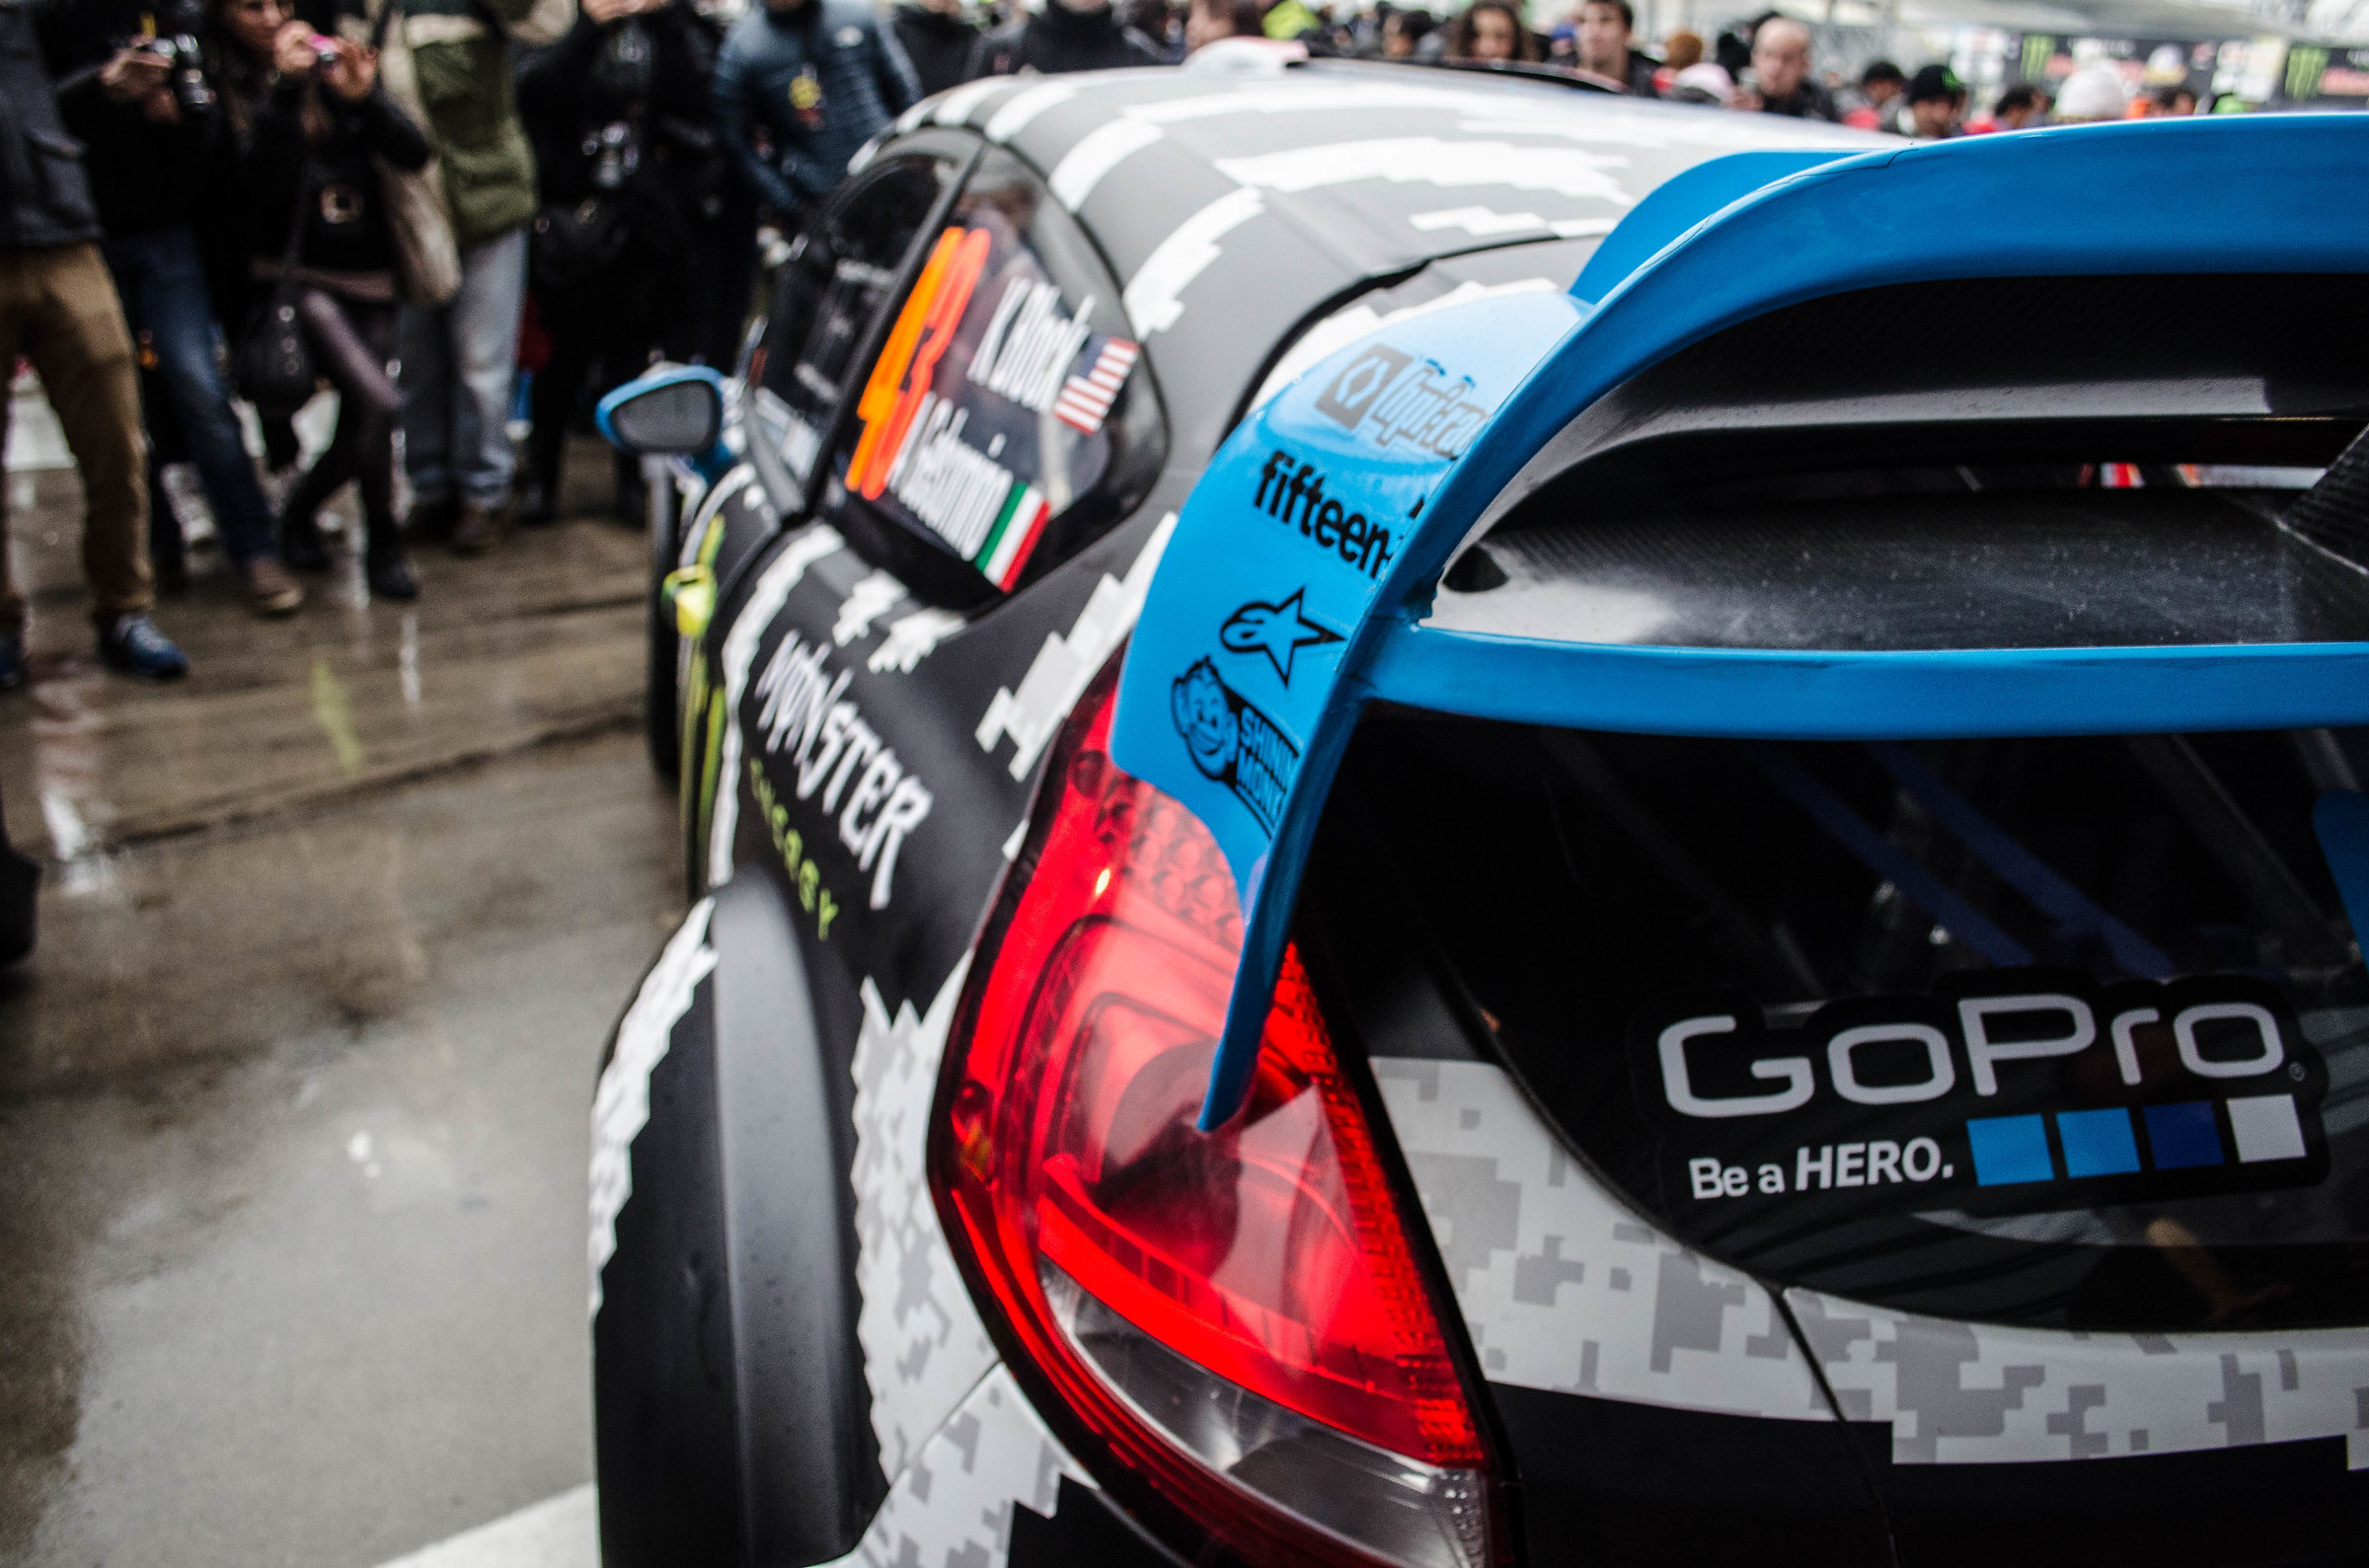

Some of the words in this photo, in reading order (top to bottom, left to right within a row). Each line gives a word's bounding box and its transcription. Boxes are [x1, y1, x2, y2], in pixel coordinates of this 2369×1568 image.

[1253, 450, 1425, 580] fifteen
[754, 630, 934, 911] MONSTER
[1657, 993, 2285, 1118] GoPro
[1689, 1157, 1749, 1200] Be
[1757, 1163, 1786, 1194] a
[1795, 1136, 1954, 1191] HERO.
